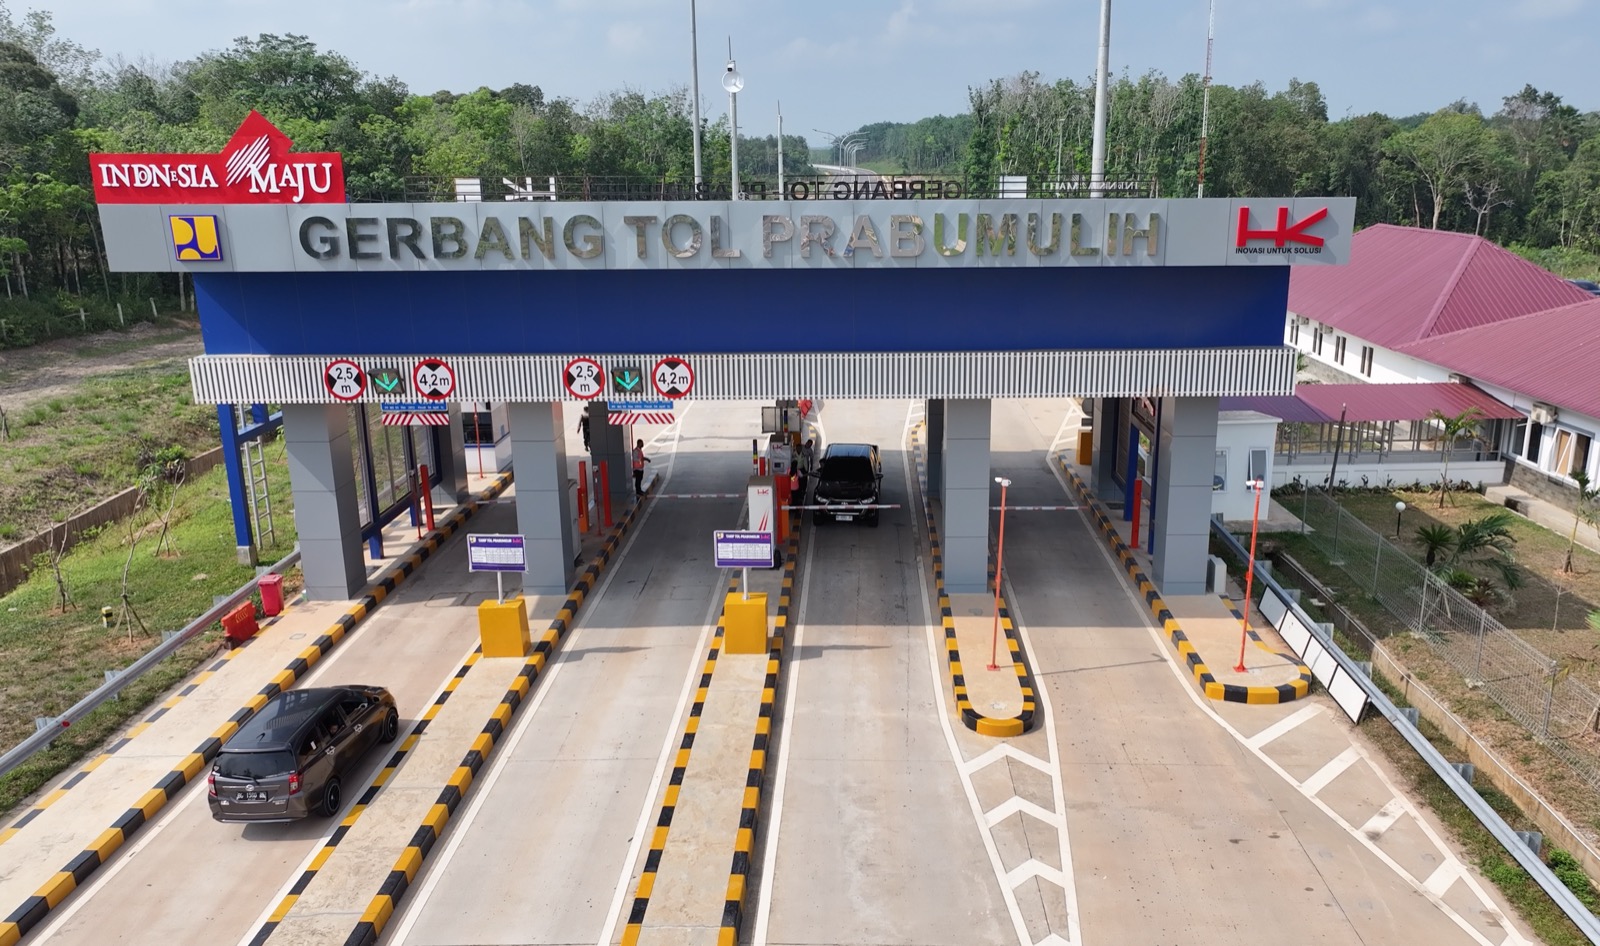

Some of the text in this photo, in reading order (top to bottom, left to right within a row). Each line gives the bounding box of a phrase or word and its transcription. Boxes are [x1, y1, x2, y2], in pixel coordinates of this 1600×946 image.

[98, 163, 332, 202] INDONESIA MAJU
[1236, 206, 1328, 247] HK
[299, 212, 1160, 260] GERBANG TOL PRABUMULIH
[336, 367, 353, 382] 2,5
[575, 365, 594, 381] 2,5
[341, 384, 352, 394] m
[580, 383, 590, 393] m
